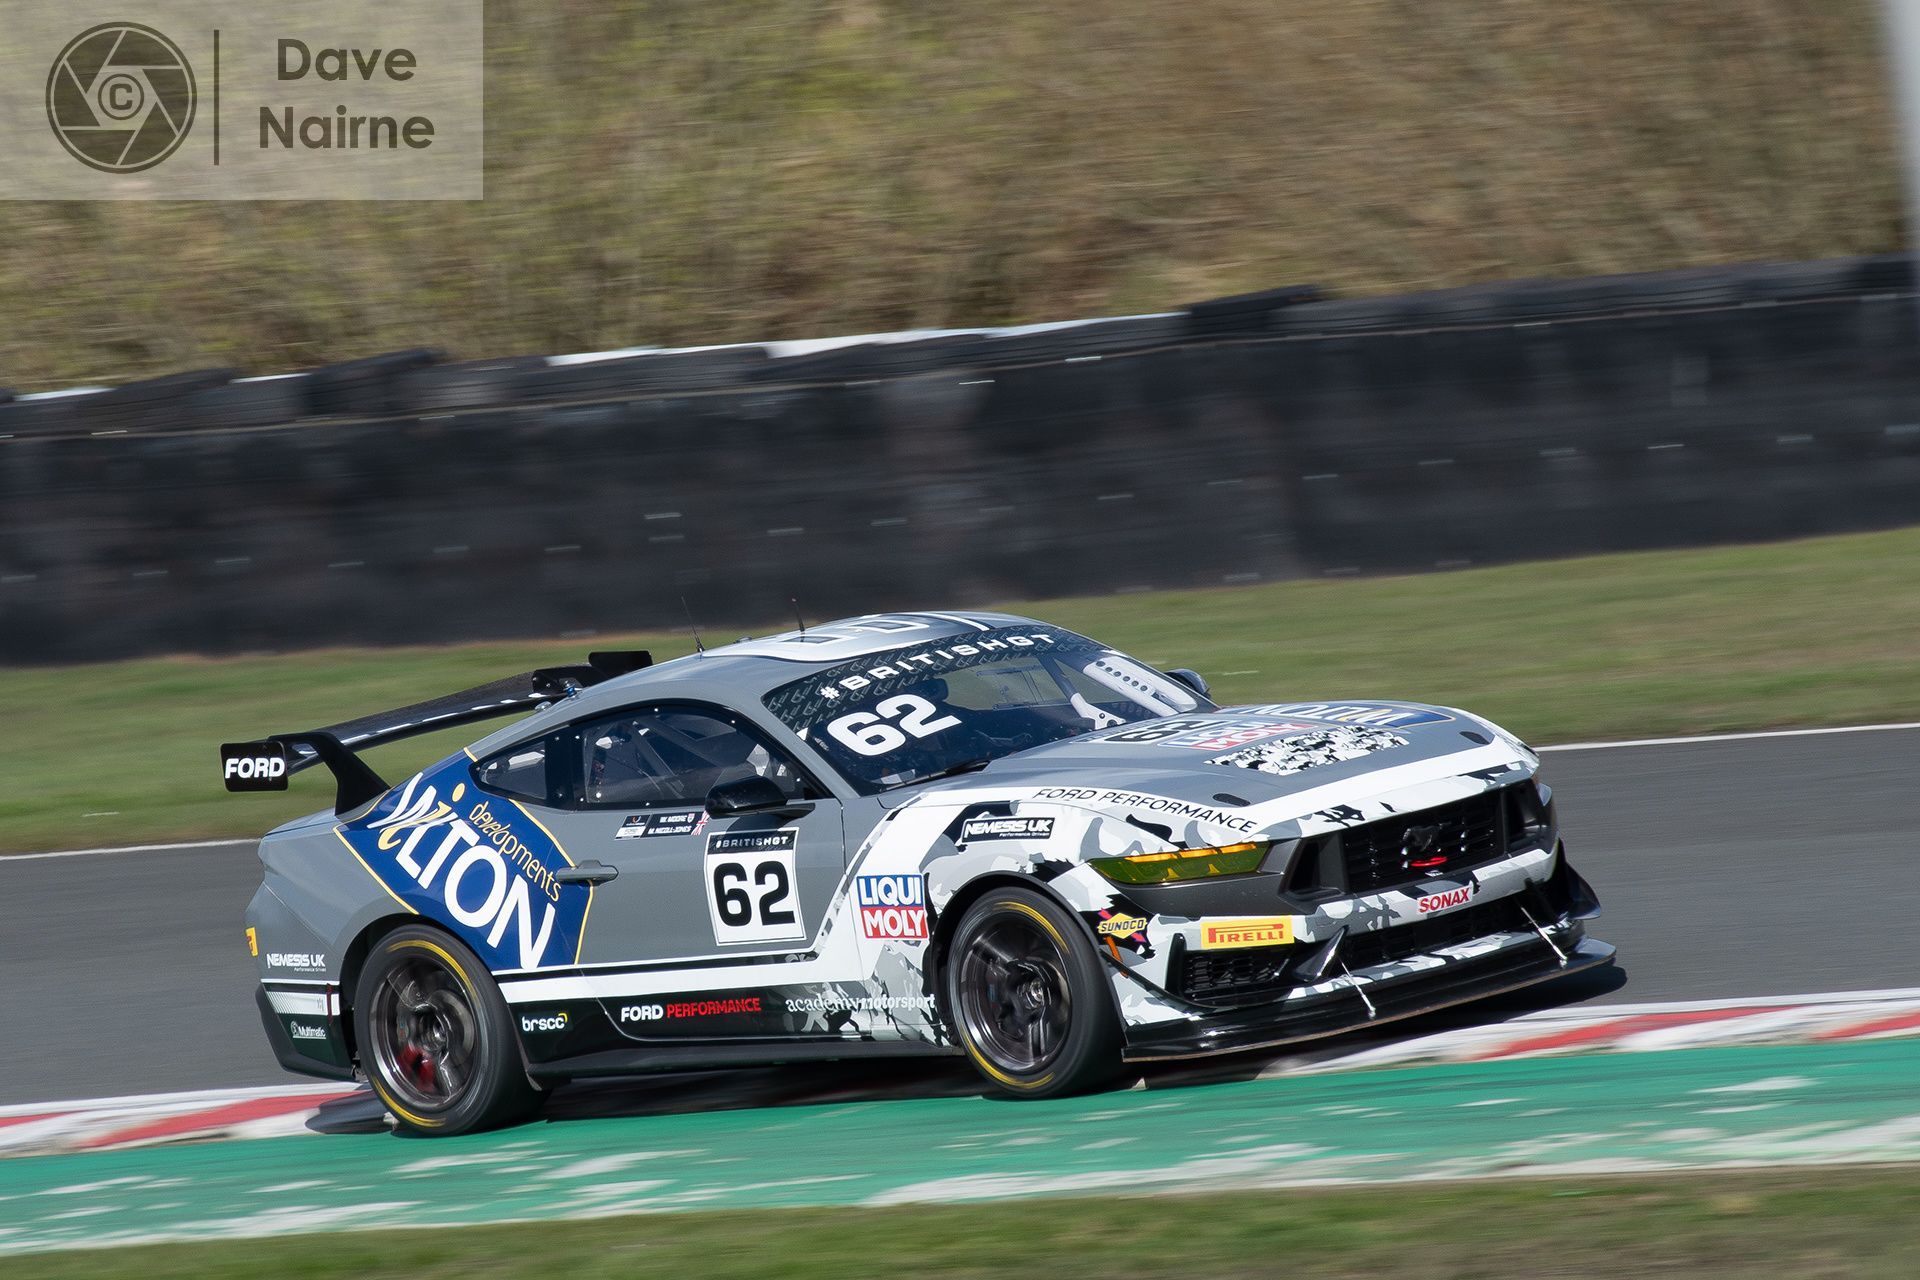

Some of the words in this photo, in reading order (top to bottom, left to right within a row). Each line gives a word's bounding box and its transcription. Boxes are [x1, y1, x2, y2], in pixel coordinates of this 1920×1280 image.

[820, 634, 1055, 700] #BRITISHGT
[827, 694, 963, 756] 62
[1104, 720, 1230, 742] 62
[225, 757, 285, 779] FORD
[1032, 788, 1097, 800] FORD
[1098, 791, 1258, 833] PERFORMANCE
[964, 820, 1027, 838] NEMESIS
[1027, 819, 1053, 832] UK
[469, 801, 562, 902] developments
[713, 861, 796, 927] 62
[858, 876, 923, 907] LIQUI
[1419, 887, 1469, 913] SONAX
[863, 908, 926, 938] MOLY
[1100, 918, 1146, 933] SUNOCO
[1208, 923, 1284, 945] PIRELLI
[266, 953, 310, 969] NEMESIS
[310, 953, 326, 967] UK
[522, 1014, 565, 1032] brscc
[620, 1004, 664, 1023] FORD
[666, 997, 761, 1019] PERFORMANCE
[299, 1026, 326, 1037] Multimatic
